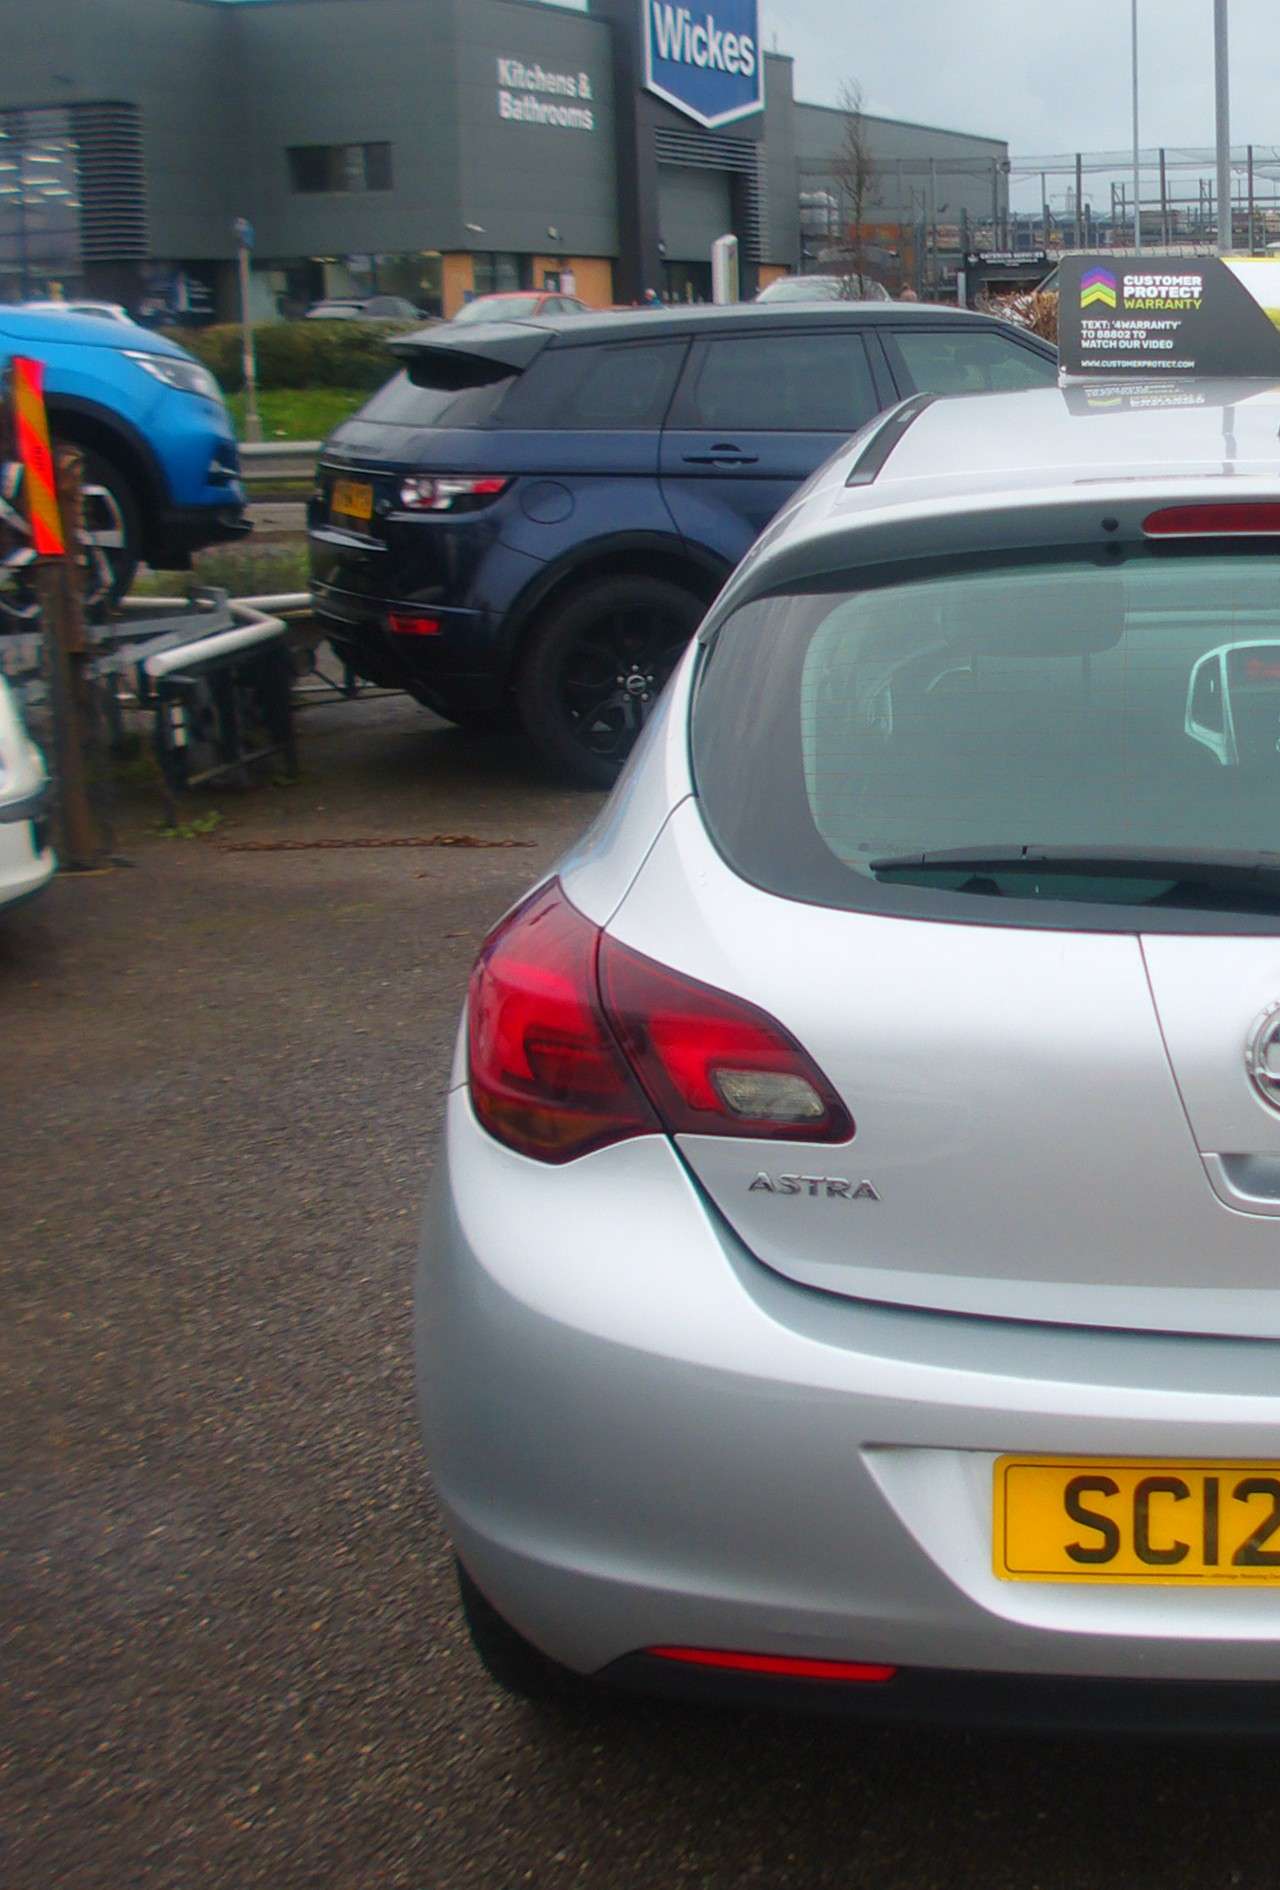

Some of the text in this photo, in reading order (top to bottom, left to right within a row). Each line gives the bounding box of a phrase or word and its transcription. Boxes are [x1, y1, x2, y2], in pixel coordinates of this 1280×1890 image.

[653, 2, 755, 77] Wickes
[497, 58, 592, 99] Kitchens &
[498, 90, 593, 130] Bathrooms
[1123, 275, 1202, 286] CUSTOMER
[1123, 286, 1202, 298] PROTECT
[1123, 299, 1202, 309] WARRANTY
[1081, 320, 1110, 329] TEXT:
[1081, 330, 1095, 339] TO
[1132, 330, 1146, 339] TO
[1081, 339, 1174, 349] WATCH OUR VIDEO
[1080, 360, 1195, 368] WWW.CUSTOMERPROTECT.COM
[749, 1172, 881, 1201] ASTRA
